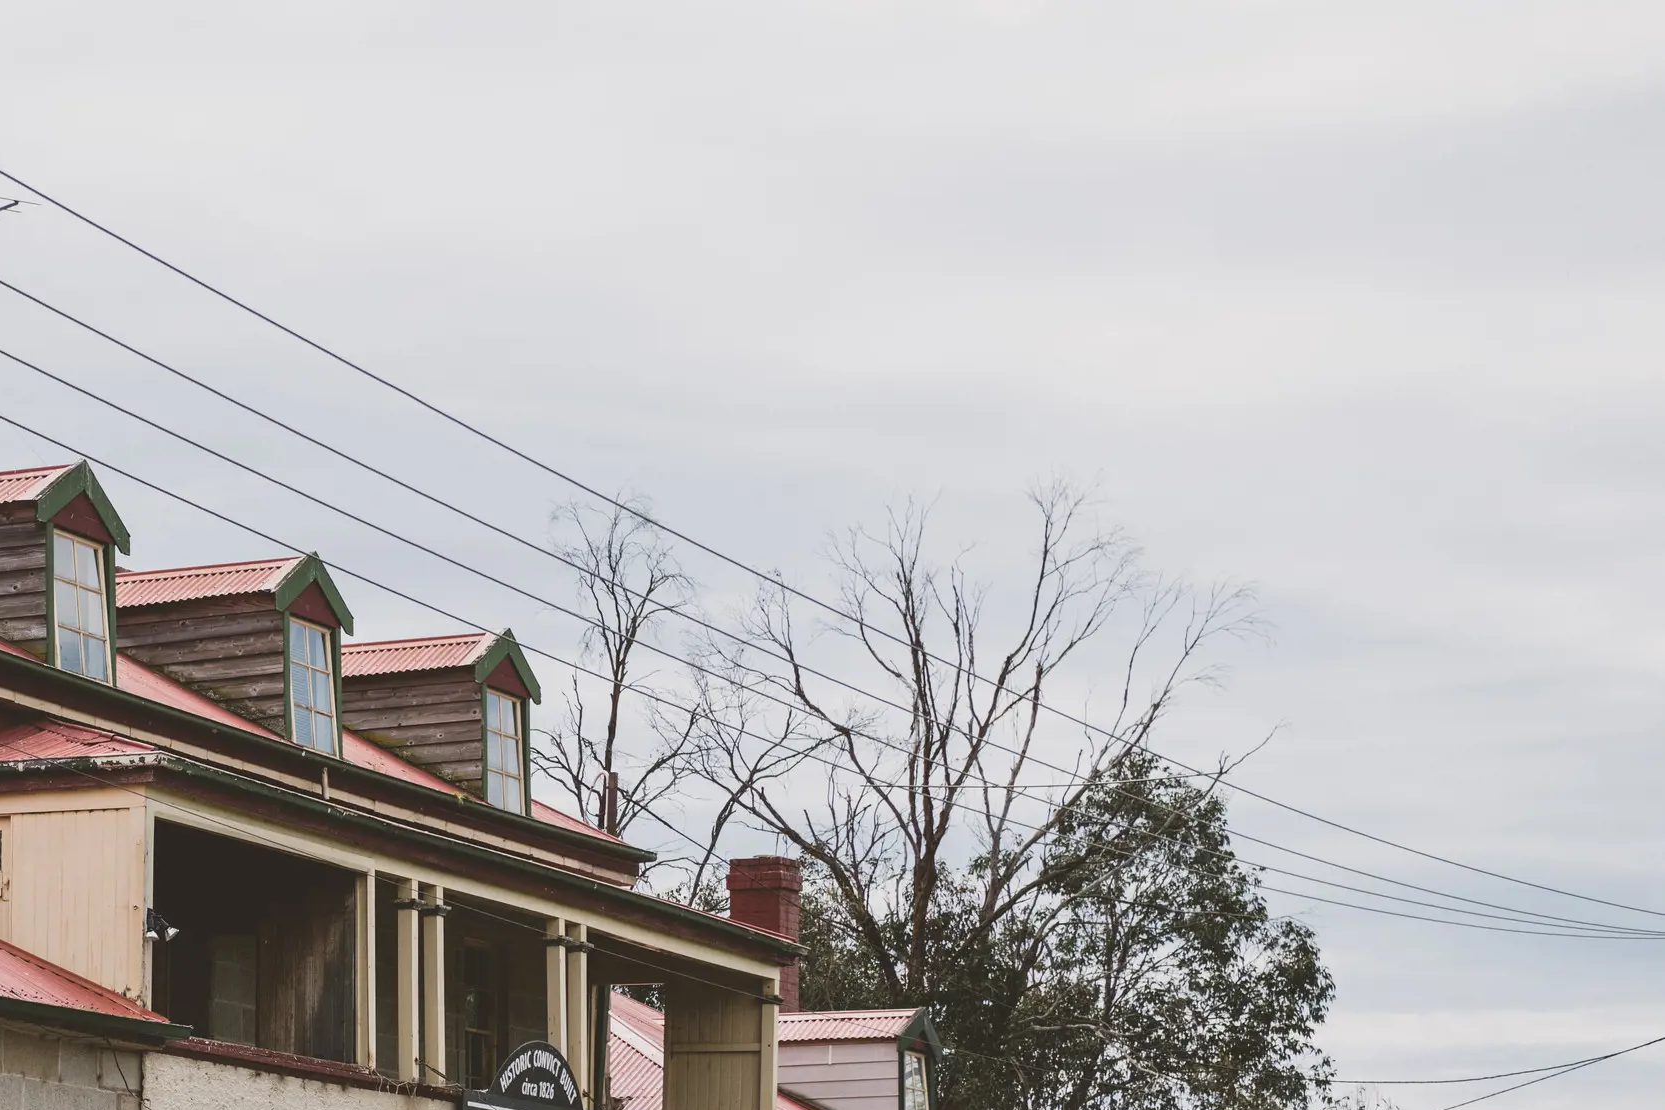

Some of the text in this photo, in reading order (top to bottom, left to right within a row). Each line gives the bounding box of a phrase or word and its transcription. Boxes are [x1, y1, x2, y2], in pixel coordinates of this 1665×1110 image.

[499, 1050, 578, 1104] HISTORIC CONVICT BUILT
[521, 1077, 555, 1100] circa 1826
